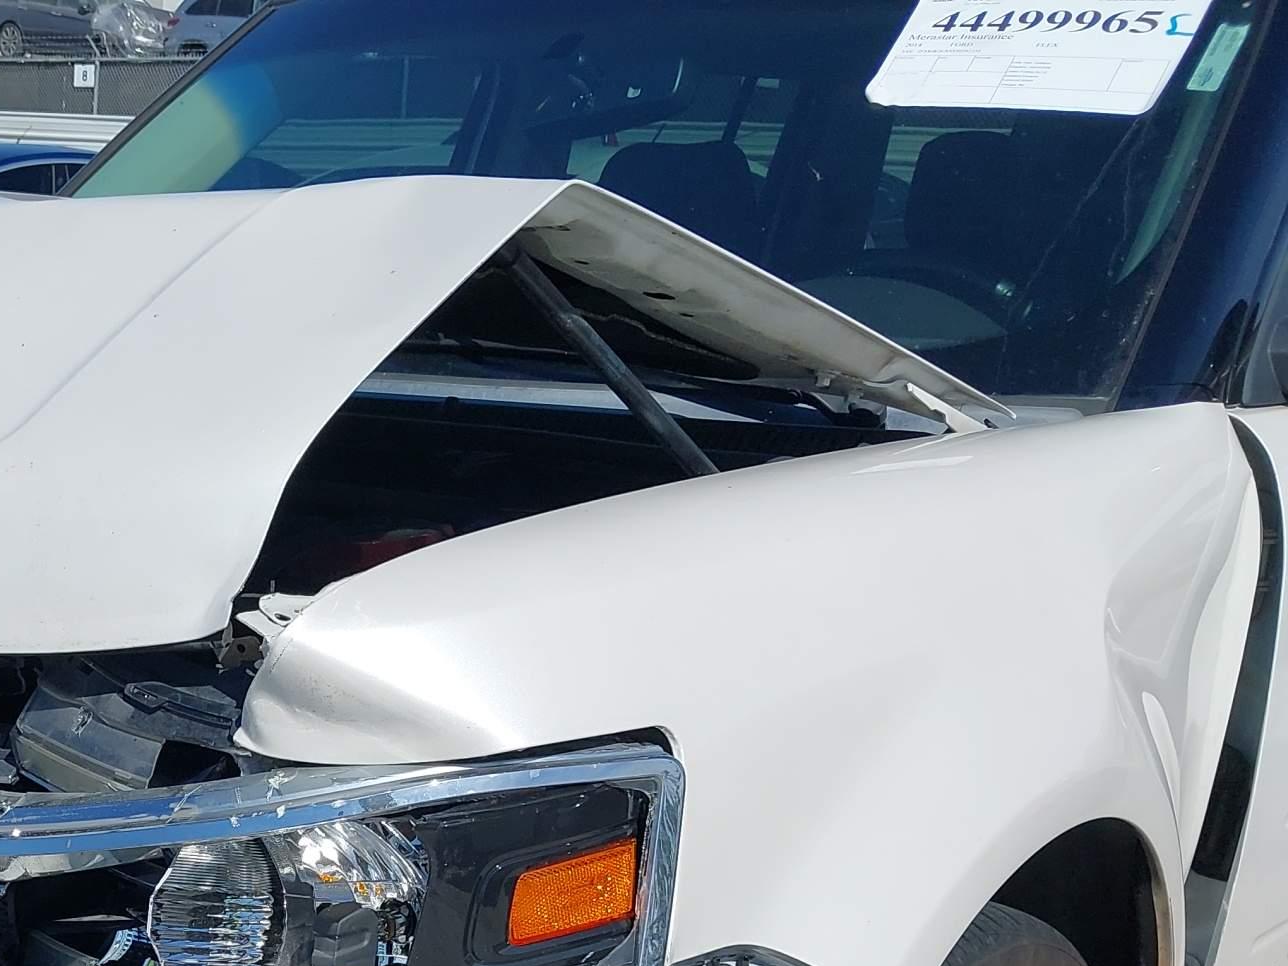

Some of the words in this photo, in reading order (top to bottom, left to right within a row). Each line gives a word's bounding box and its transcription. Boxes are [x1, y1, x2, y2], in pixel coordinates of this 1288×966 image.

[932, 9, 1164, 33] 44499965
[908, 33, 957, 41] Merastar
[82, 70, 88, 81] 8
